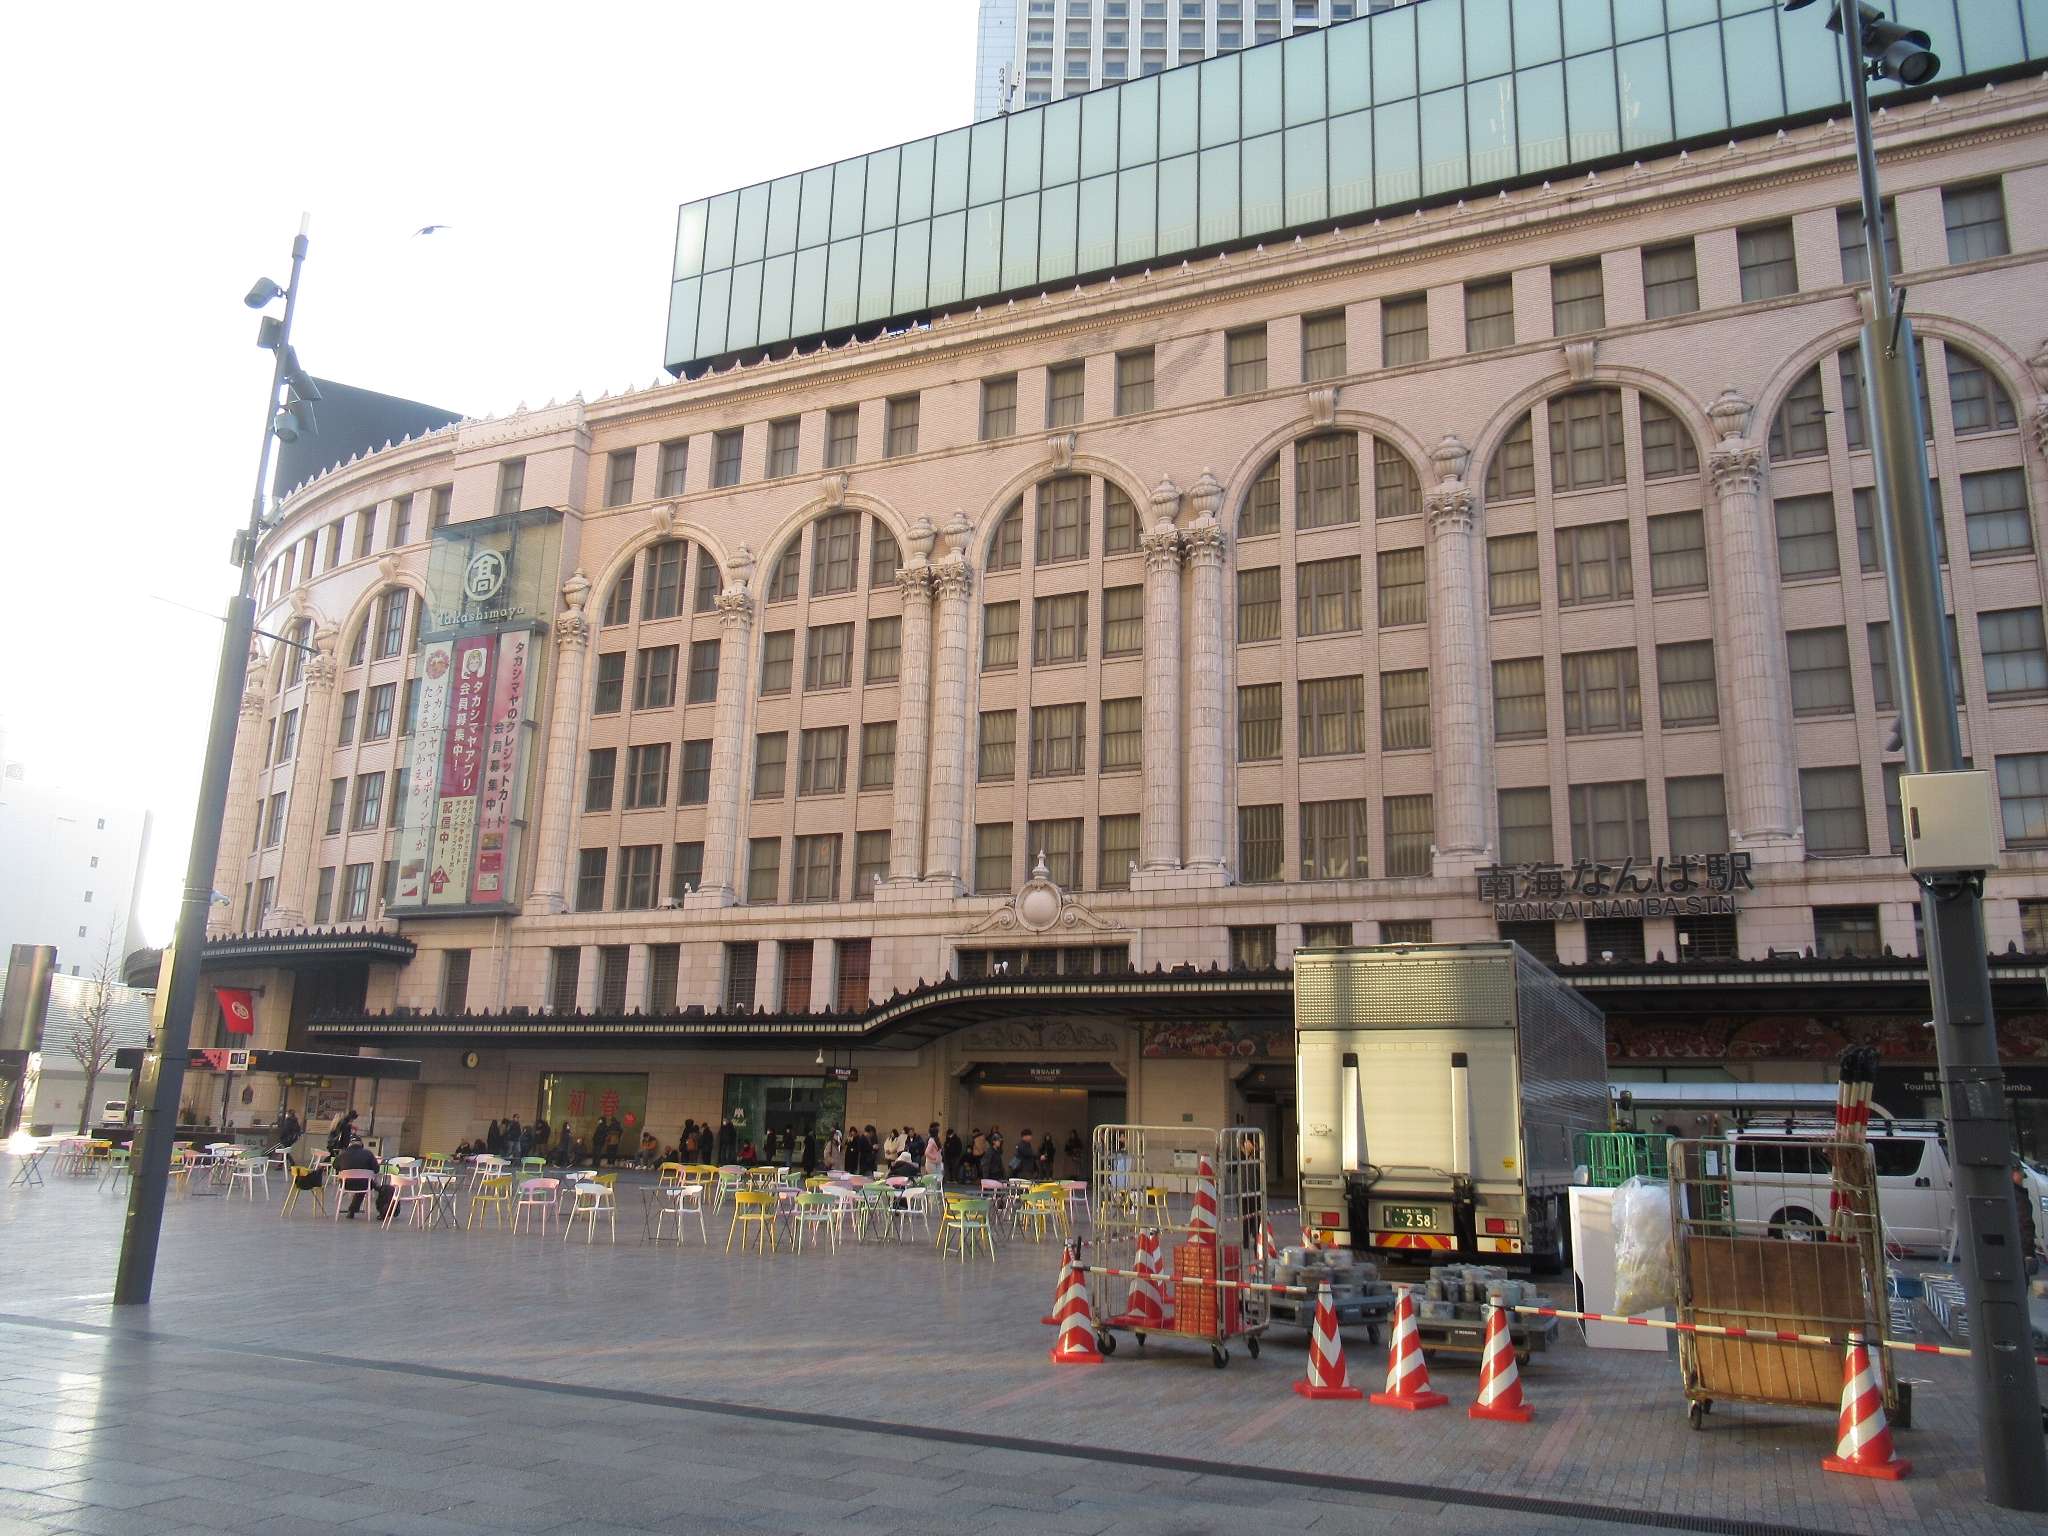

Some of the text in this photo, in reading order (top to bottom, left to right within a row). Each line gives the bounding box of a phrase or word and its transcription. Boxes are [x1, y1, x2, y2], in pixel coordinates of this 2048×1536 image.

[439, 606, 527, 626] Takashimaya
[462, 681, 484, 791] タカシマヤアプリ
[1475, 851, 1755, 902] 南海なんば駅
[1494, 894, 1744, 921] NANKAI NAMBA STN.
